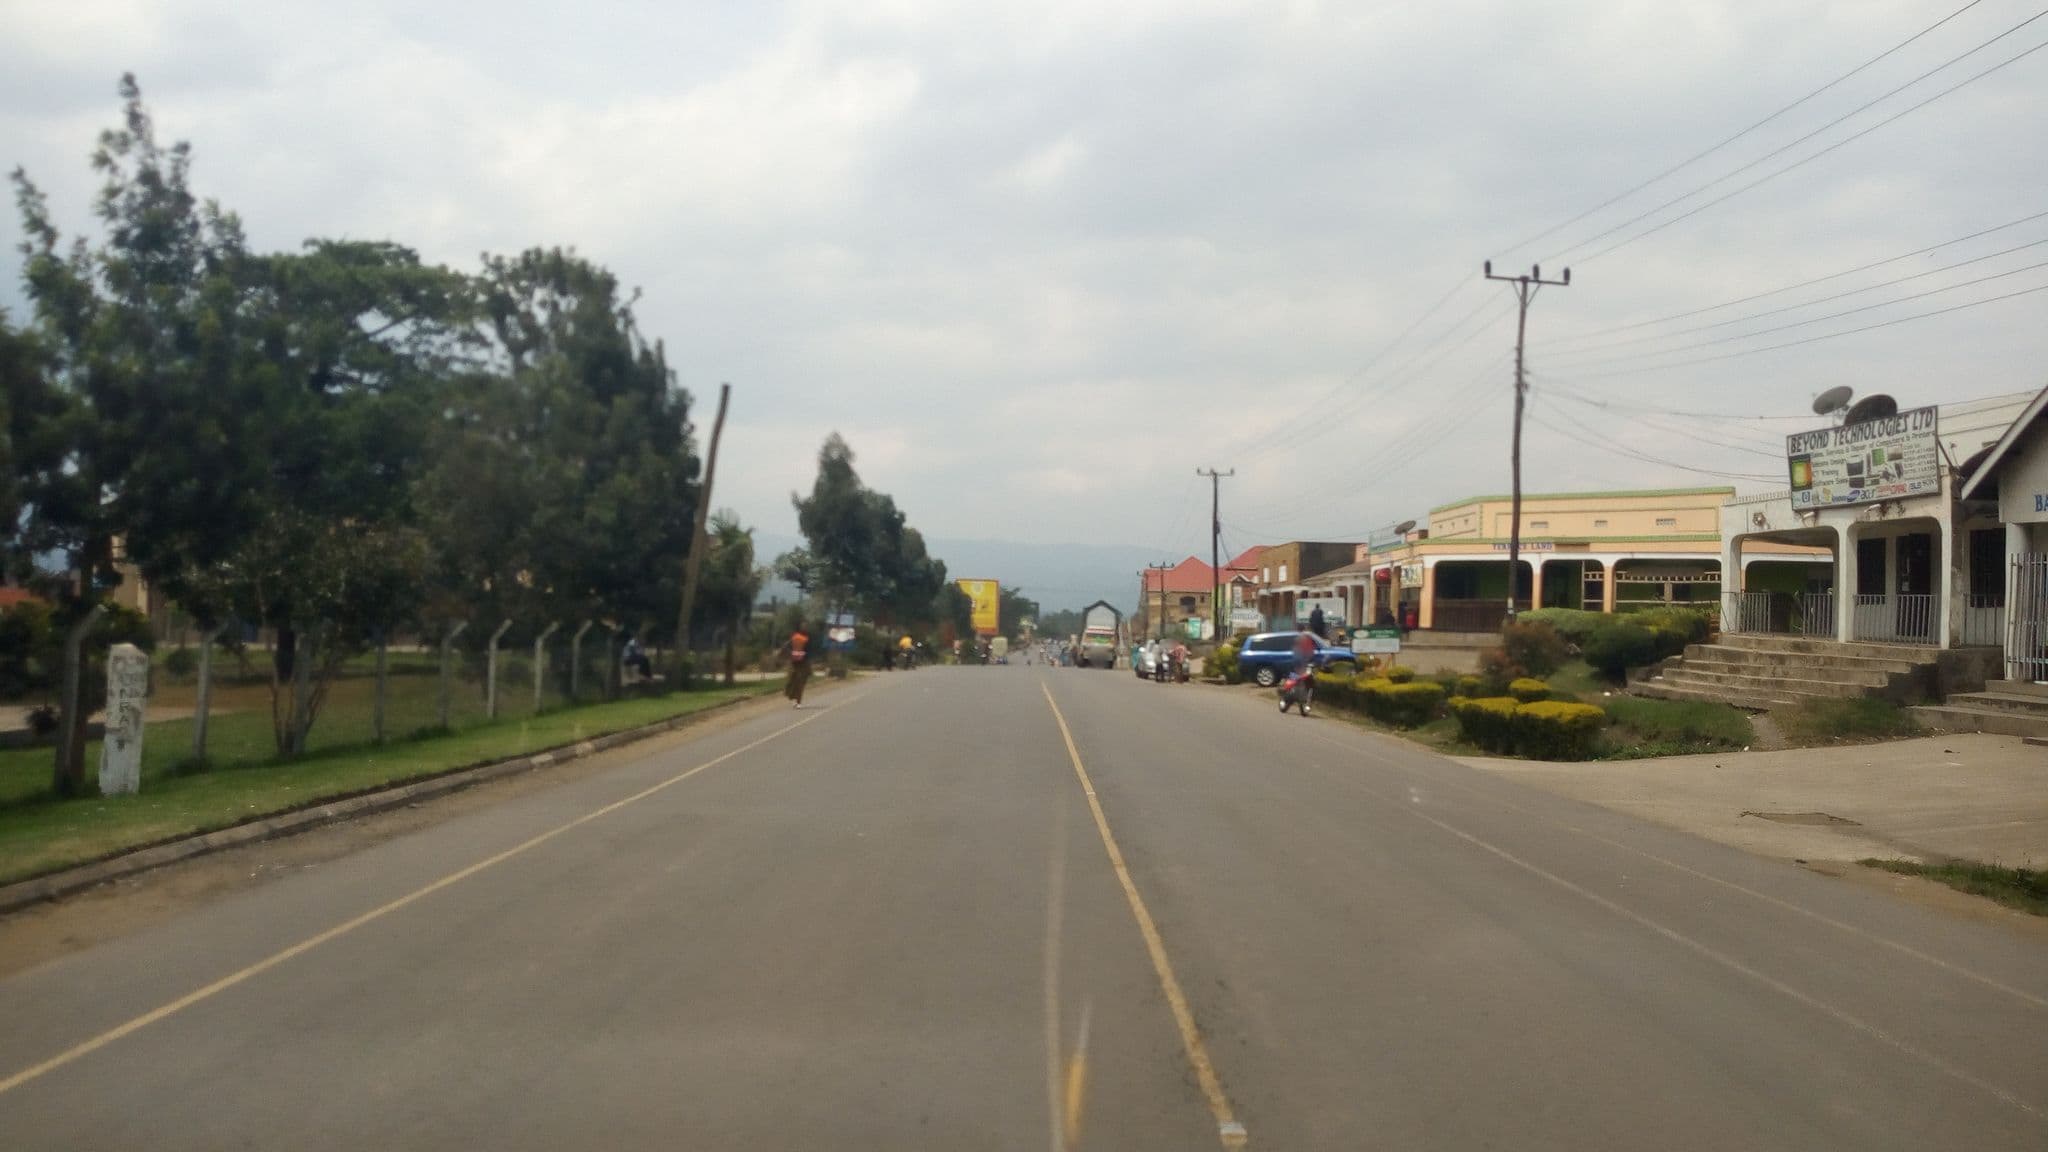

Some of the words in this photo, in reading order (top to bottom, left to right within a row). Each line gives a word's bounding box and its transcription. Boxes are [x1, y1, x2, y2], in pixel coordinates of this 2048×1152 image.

[1791, 431, 1829, 454] BEYOND
[1833, 414, 1910, 446] TECHNOLOGIES
[1912, 408, 1933, 431] LTD
